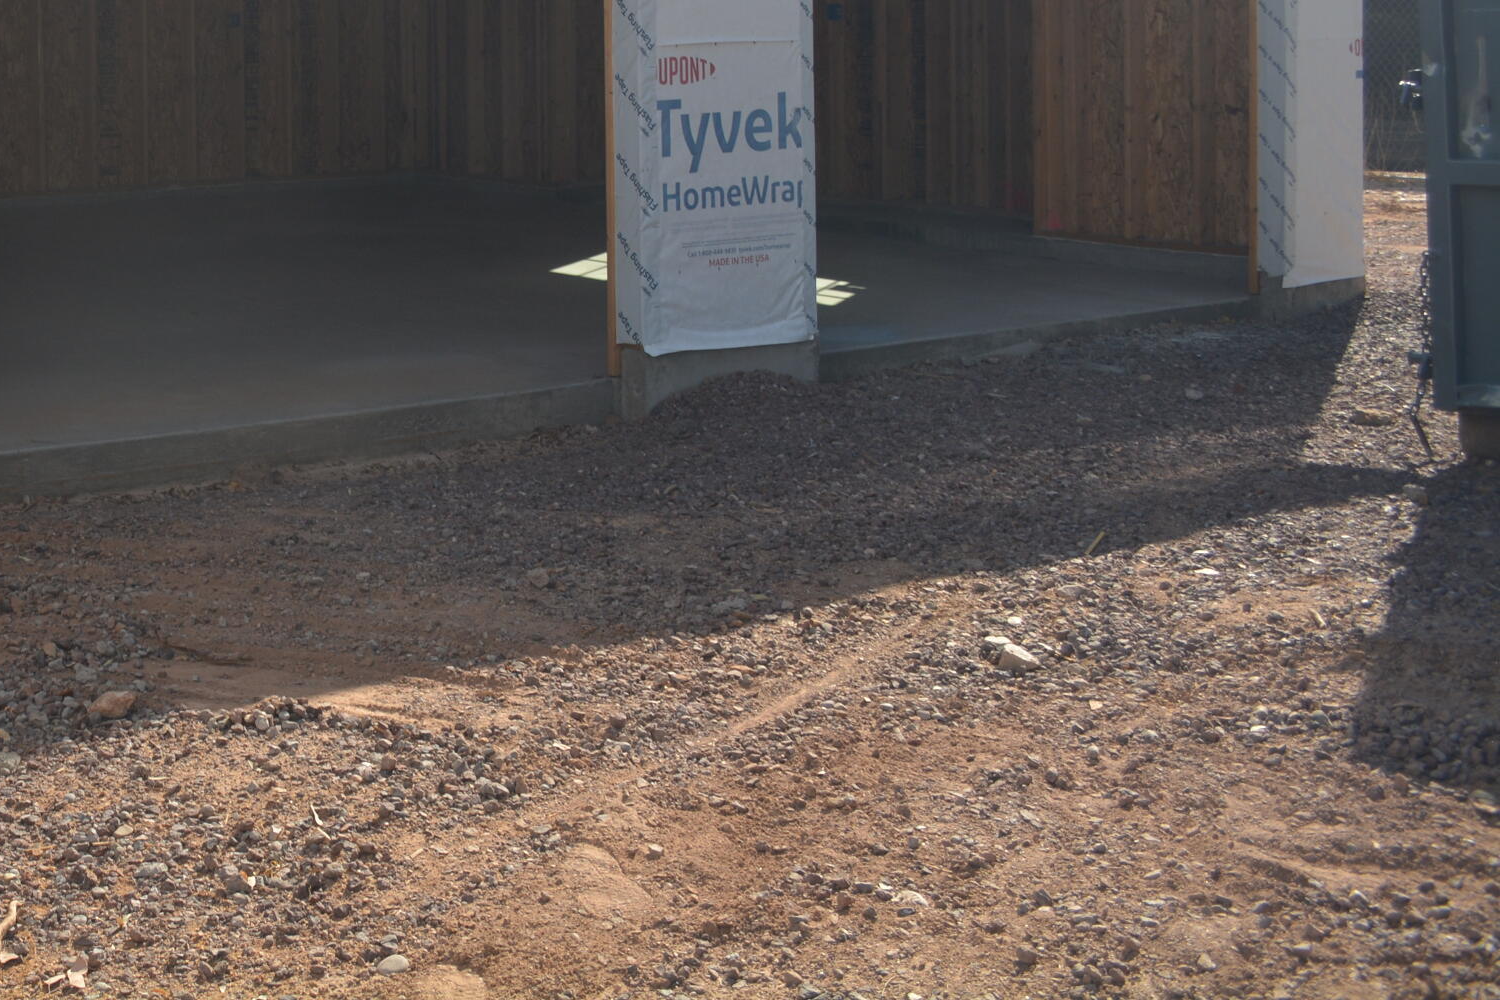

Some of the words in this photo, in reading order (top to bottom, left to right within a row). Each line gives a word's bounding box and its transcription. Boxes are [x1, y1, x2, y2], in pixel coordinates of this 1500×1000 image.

[628, 12, 655, 51] Flashing
[615, 72, 628, 97] Tape
[657, 56, 708, 86] UPONT
[629, 91, 656, 131] Flashing
[657, 92, 802, 174] Tyvek
[616, 153, 630, 176] Tape
[630, 172, 659, 211] Flashing
[617, 231, 631, 256] Tape
[631, 252, 659, 290] Flashing
[618, 311, 632, 335] Tape
